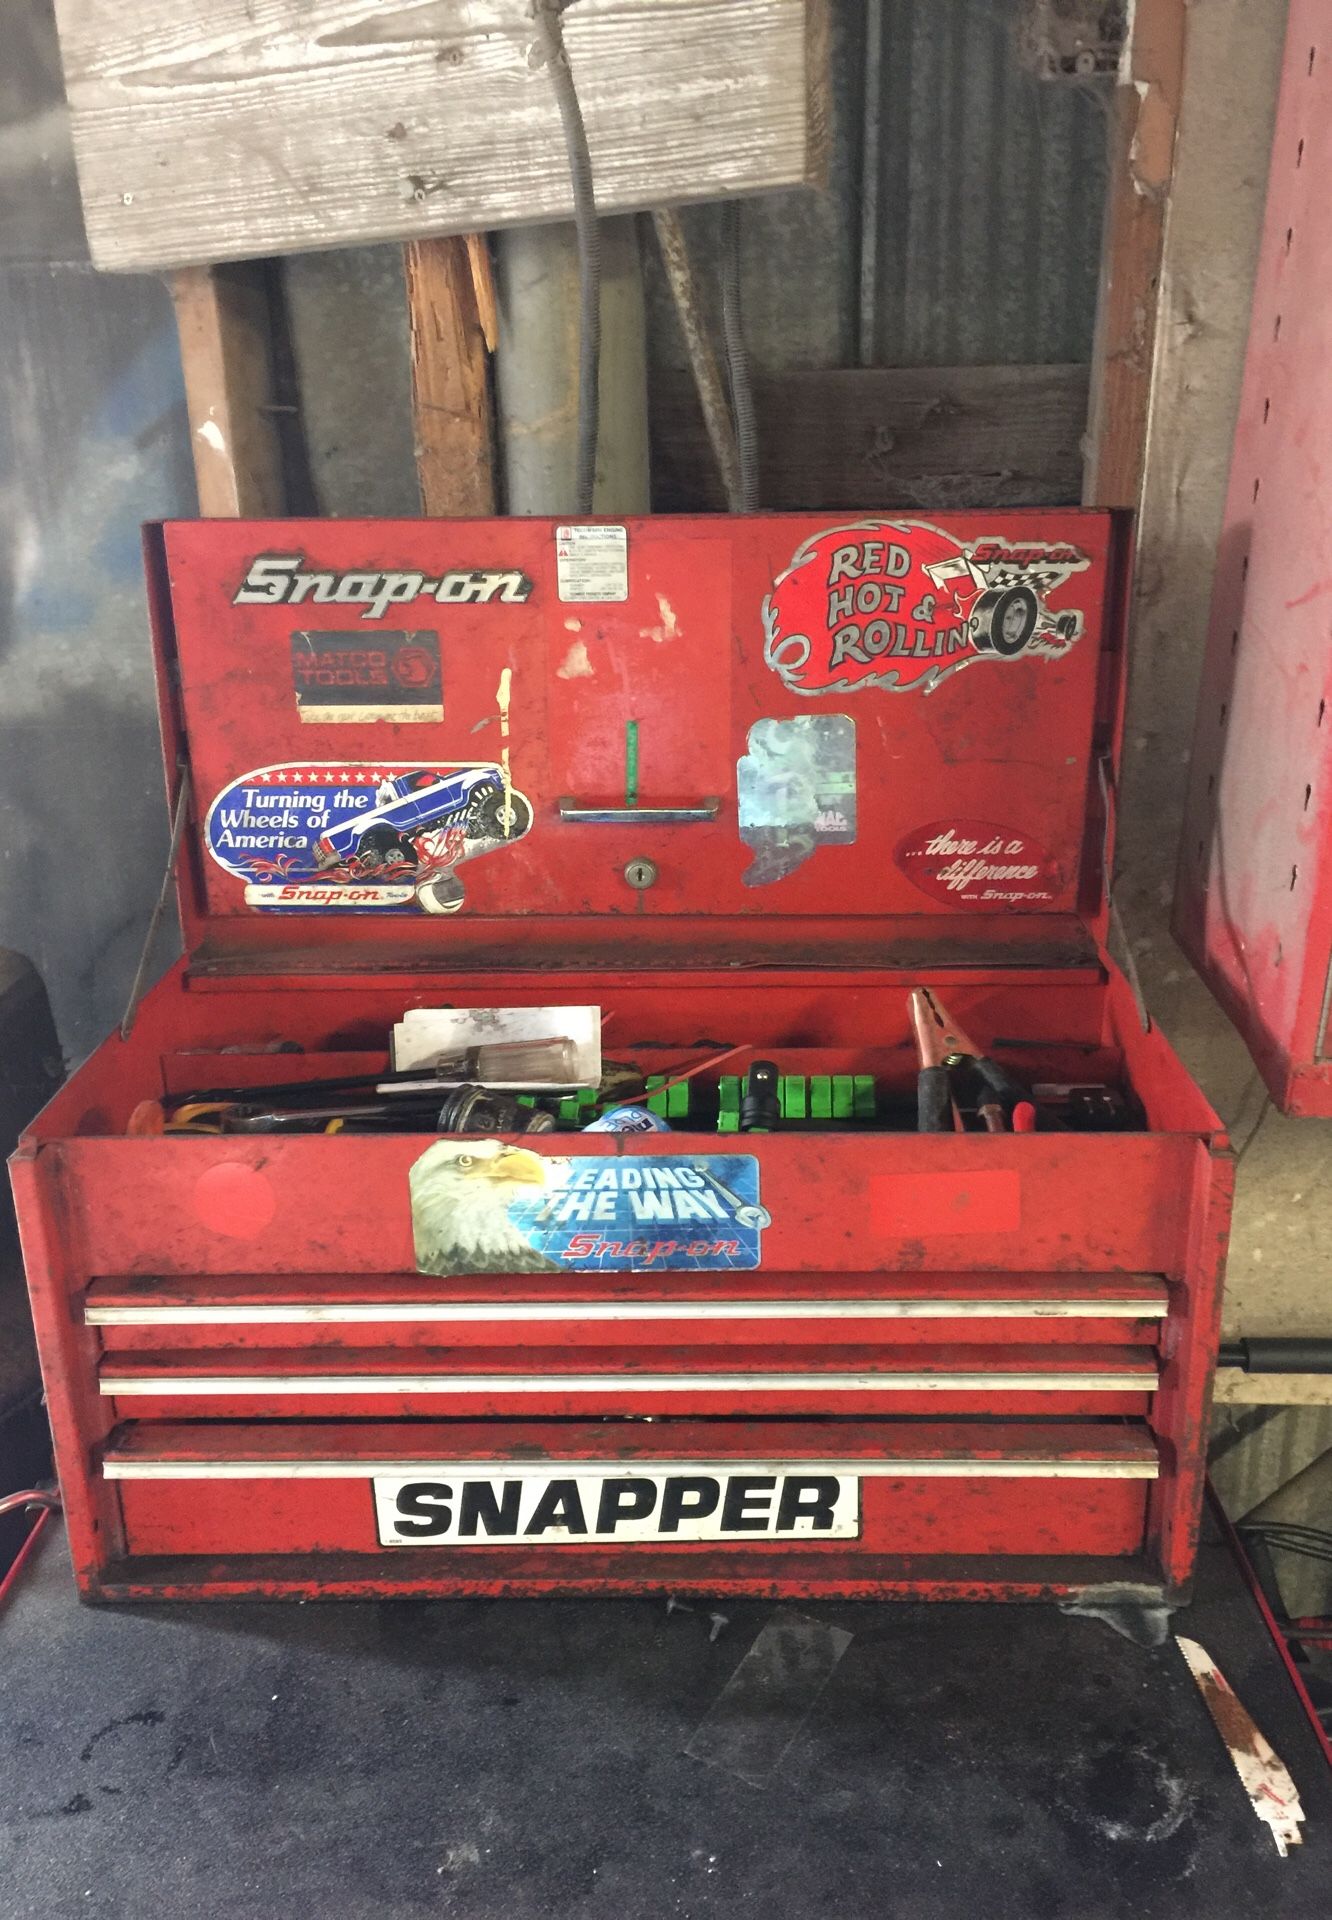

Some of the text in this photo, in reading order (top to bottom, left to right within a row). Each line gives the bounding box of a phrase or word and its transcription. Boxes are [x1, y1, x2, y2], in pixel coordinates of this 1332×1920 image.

[828, 541, 911, 588] RED
[970, 543, 1081, 569] Snap-on
[232, 554, 529, 619] Snap-on
[827, 581, 936, 628] HOT &
[295, 651, 386, 666] MATCO
[298, 669, 388, 685] TOOLS
[242, 789, 369, 812] Turning the
[220, 809, 332, 828] Wheels of
[216, 829, 308, 849] America
[977, 836, 1004, 855] is
[1004, 840, 1024, 855] a
[936, 858, 1039, 891] difference
[278, 885, 380, 905] Snap-on
[980, 889, 1051, 902] Snap-on
[553, 1167, 706, 1189] LEADING
[535, 1189, 731, 1223] THE WAY
[561, 1233, 742, 1264] Snap-on
[393, 1475, 841, 1537] SNAPPER
